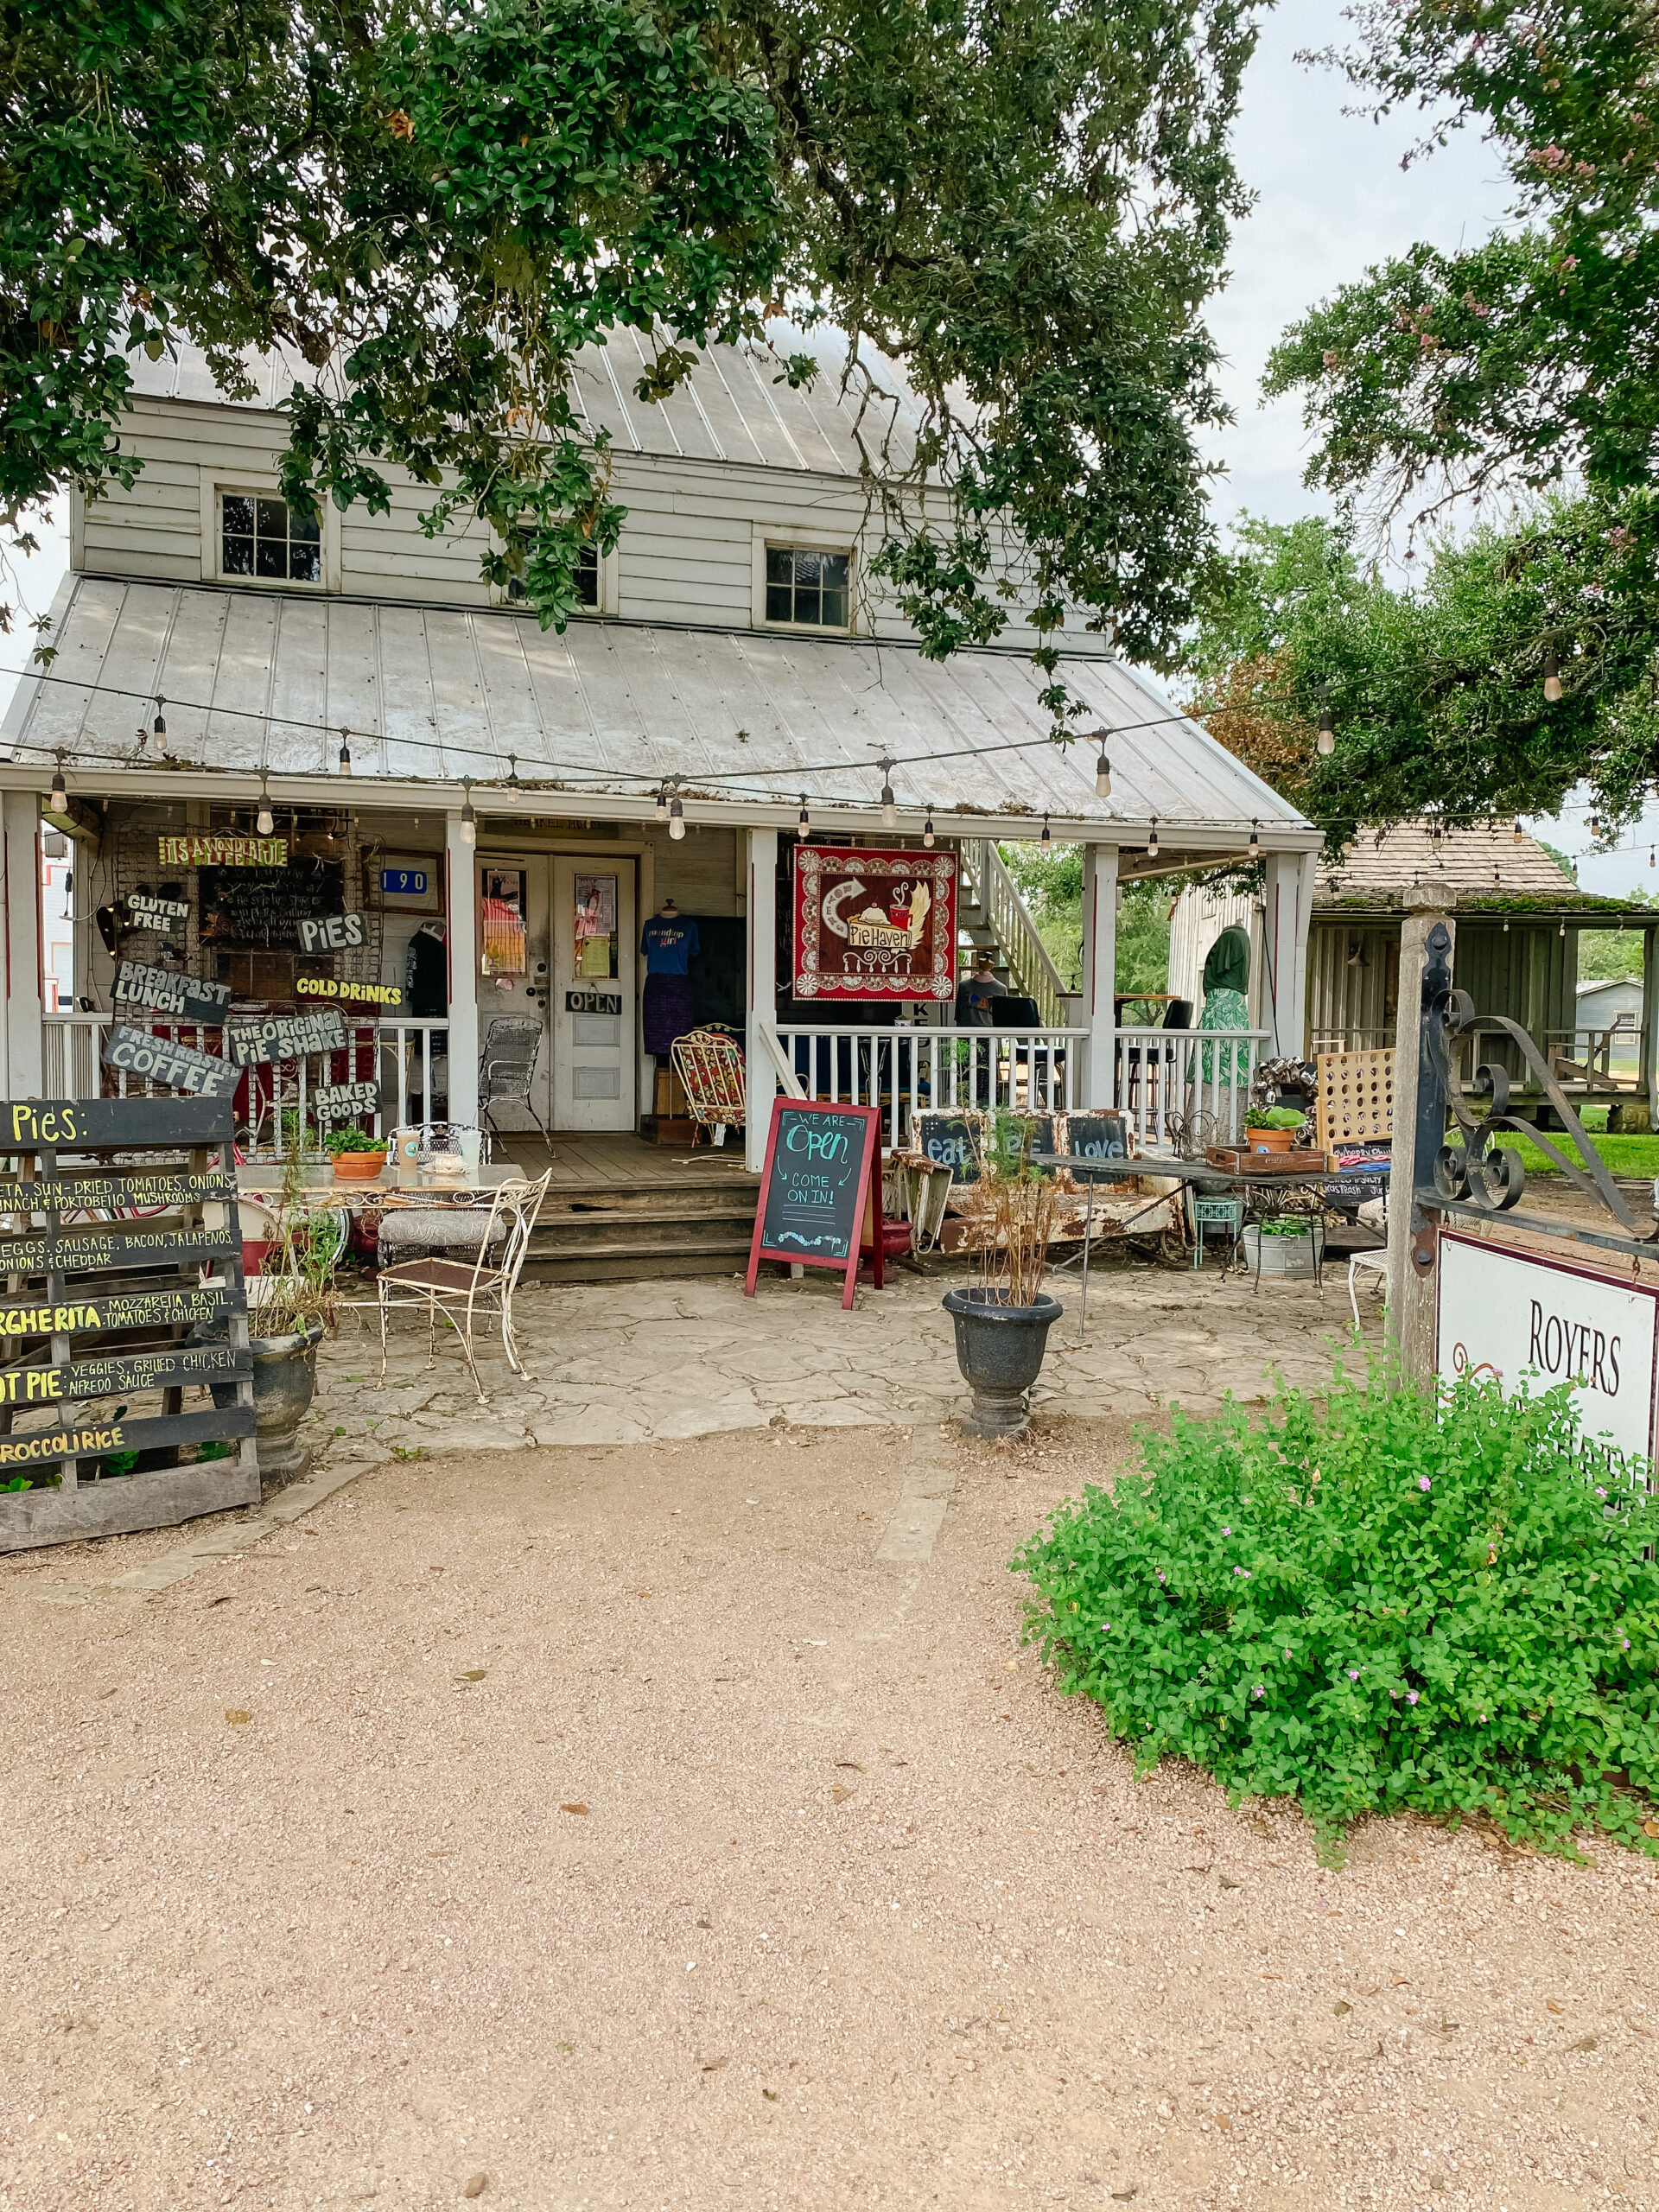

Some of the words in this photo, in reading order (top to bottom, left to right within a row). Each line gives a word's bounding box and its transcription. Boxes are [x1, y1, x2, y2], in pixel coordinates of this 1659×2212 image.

[202, 838, 283, 865] WONDERFUL
[127, 894, 189, 918] GLUTEN
[133, 911, 171, 932] FREE
[116, 981, 185, 1014] LUNCH
[296, 977, 338, 996] COLD
[570, 992, 619, 1016] OPEN
[118, 1026, 175, 1057] FRESH
[231, 1025, 261, 1042] THE
[112, 1042, 225, 1096] COFFEE
[315, 1082, 378, 1106] BAKED
[316, 1097, 377, 1121] GOODS
[798, 1113, 819, 1125] WE
[822, 1116, 846, 1127] ARE
[785, 1124, 849, 1165] Open
[927, 1135, 970, 1166] eat
[791, 1172, 830, 1188] COME
[132, 1192, 202, 1205] MUSHROOMS
[787, 1189, 808, 1204] ON
[810, 1189, 835, 1205] IN!
[0, 1255, 44, 1272] ONIONS
[55, 1252, 112, 1268] CHEDDAR
[104, 1307, 162, 1328] TOMATOES
[171, 1306, 214, 1322] CHICKEN
[1529, 1299, 1621, 1397] ROYERS
[134, 1357, 176, 1373] GRILLED
[182, 1350, 237, 1373] CHICKEN
[118, 1372, 156, 1391] SAUCE
